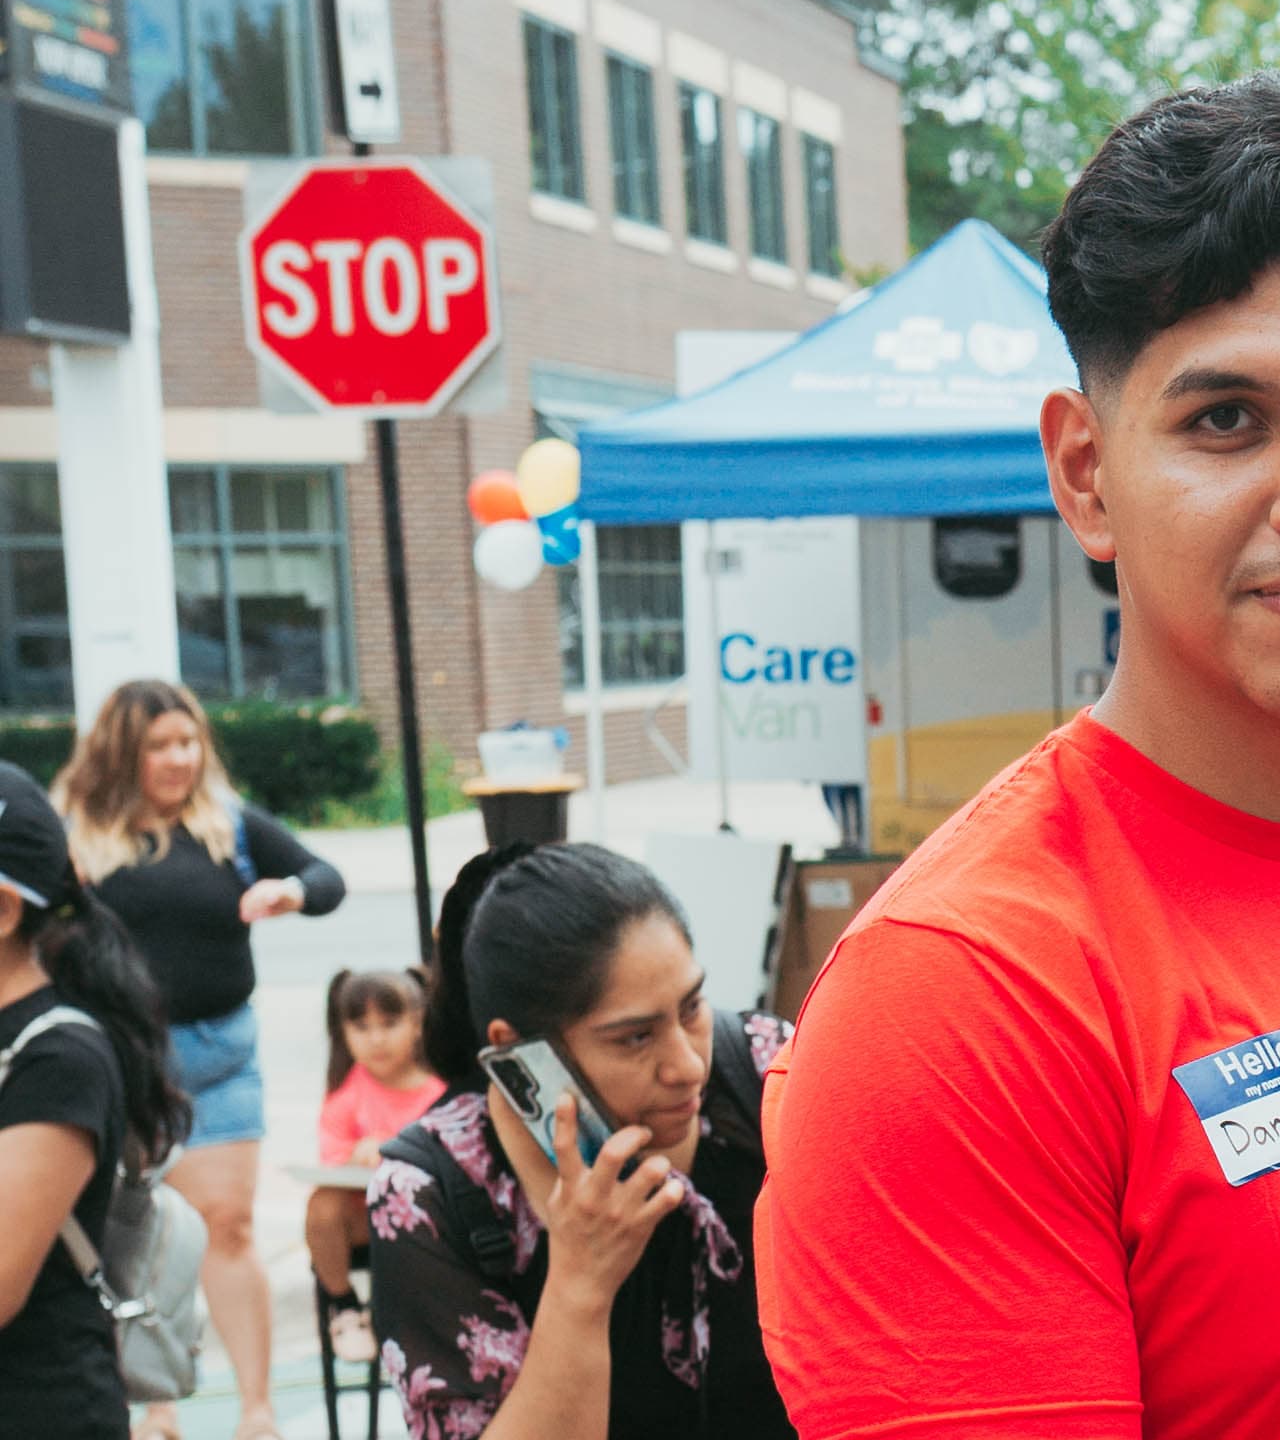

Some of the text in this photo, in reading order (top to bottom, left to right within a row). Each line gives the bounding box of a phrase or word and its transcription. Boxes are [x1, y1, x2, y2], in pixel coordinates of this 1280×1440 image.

[262, 237, 478, 338] STOP
[720, 633, 855, 684] Care
[720, 692, 820, 740] Van
[1245, 1084, 1262, 1098] my
